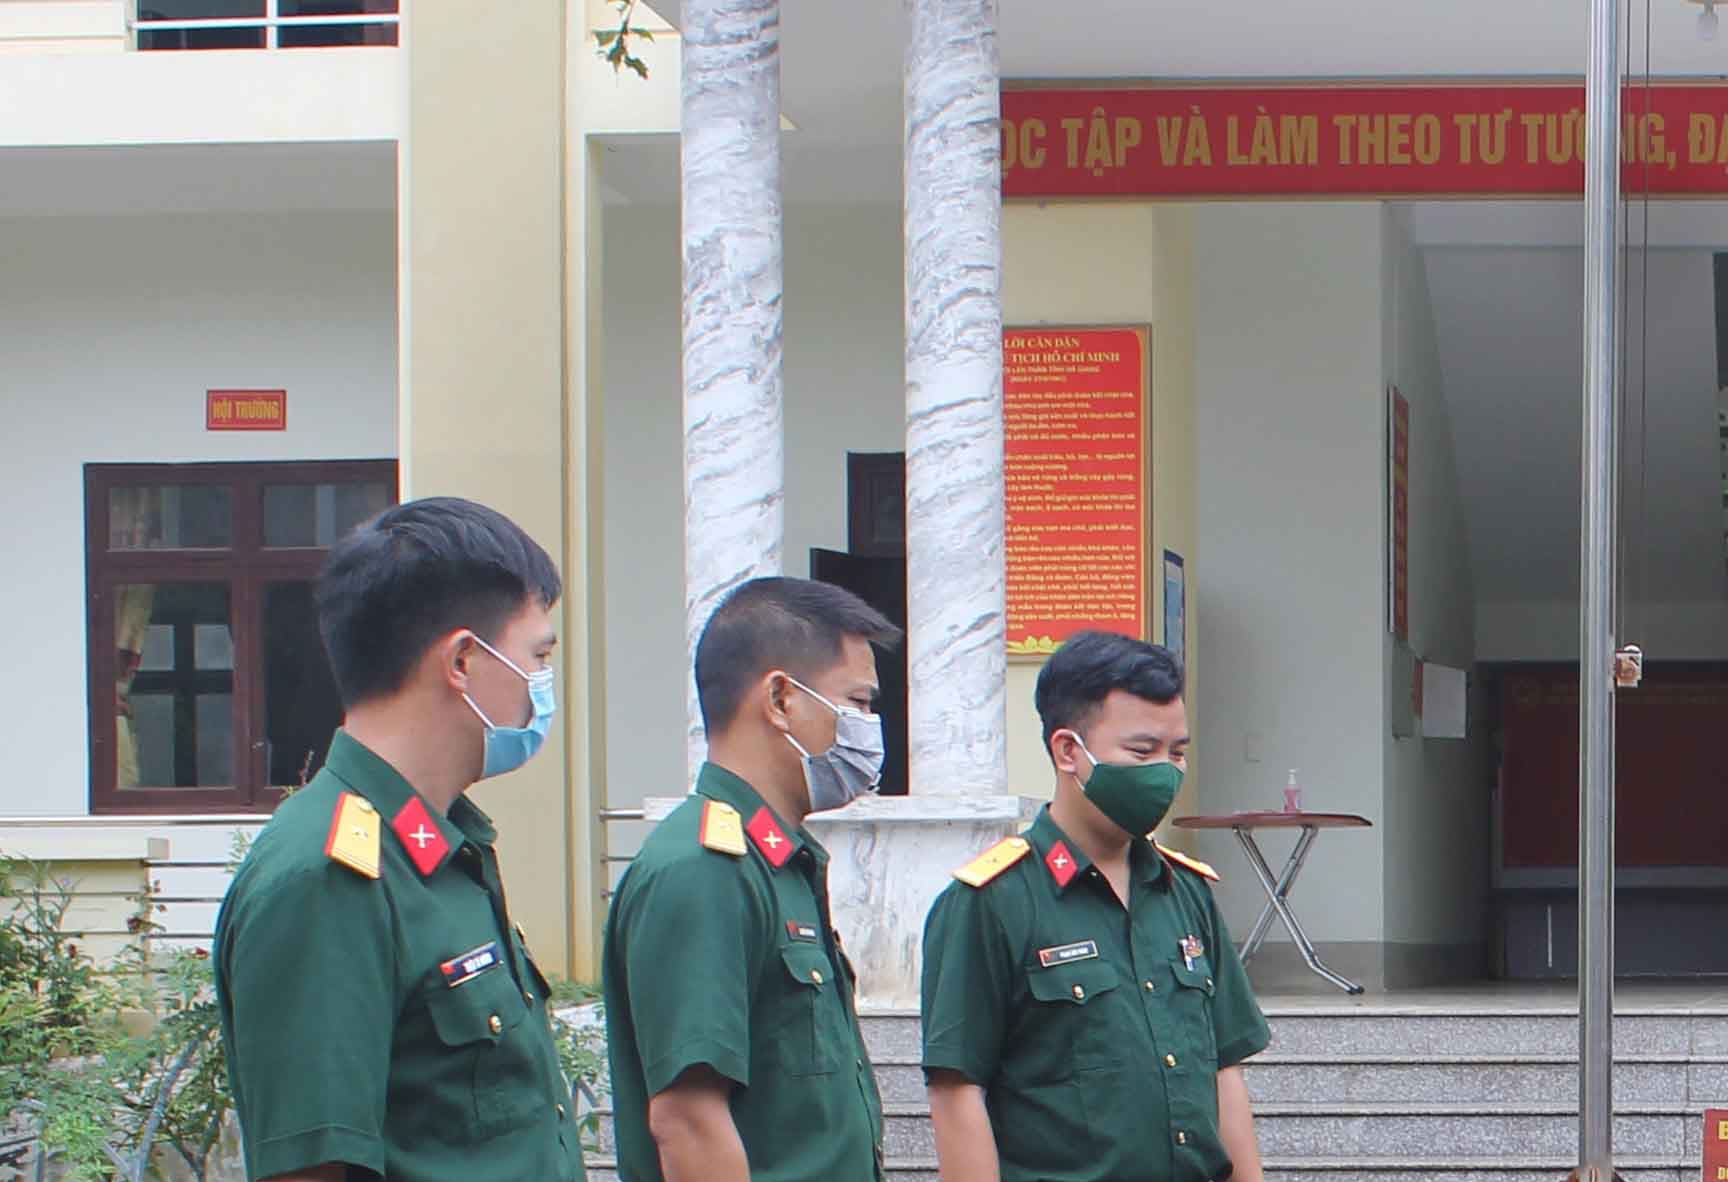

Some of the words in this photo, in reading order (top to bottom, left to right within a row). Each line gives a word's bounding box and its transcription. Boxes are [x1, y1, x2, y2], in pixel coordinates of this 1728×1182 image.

[1001, 117, 1047, 178] ỌC
[1061, 106, 1142, 177] TẬP
[1157, 105, 1212, 167] VÀ
[1227, 105, 1318, 166] LÀM
[1334, 114, 1441, 166] THEO
[1454, 108, 1512, 164] TƯ
[1042, 349, 1061, 363] HỒ
[1063, 351, 1084, 363] CHÍ
[1086, 351, 1120, 362] MINH
